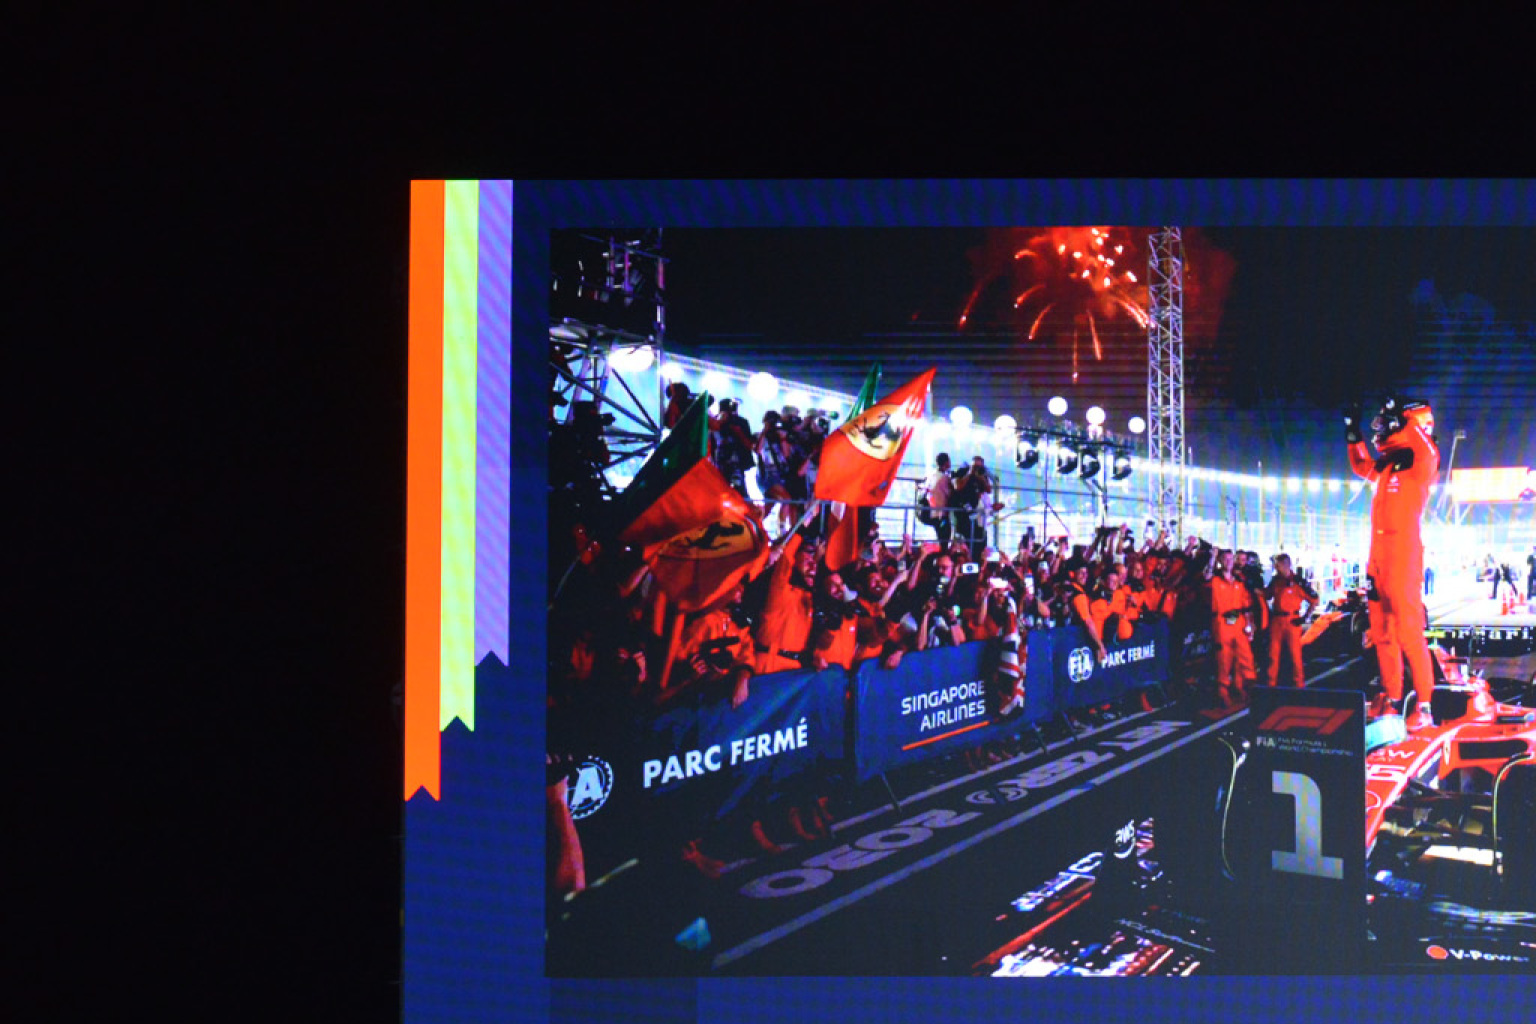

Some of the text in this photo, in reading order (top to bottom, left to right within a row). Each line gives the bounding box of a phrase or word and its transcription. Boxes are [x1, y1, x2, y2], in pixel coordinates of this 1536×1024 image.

[1101, 650, 1126, 669] PARC
[1128, 640, 1156, 662] FERMÉ
[901, 680, 985, 715] SINGAPORE
[920, 699, 986, 732] AIRLINES
[642, 743, 723, 789] PARC
[729, 716, 808, 766] FERMÉ
[1271, 770, 1344, 880] 1
